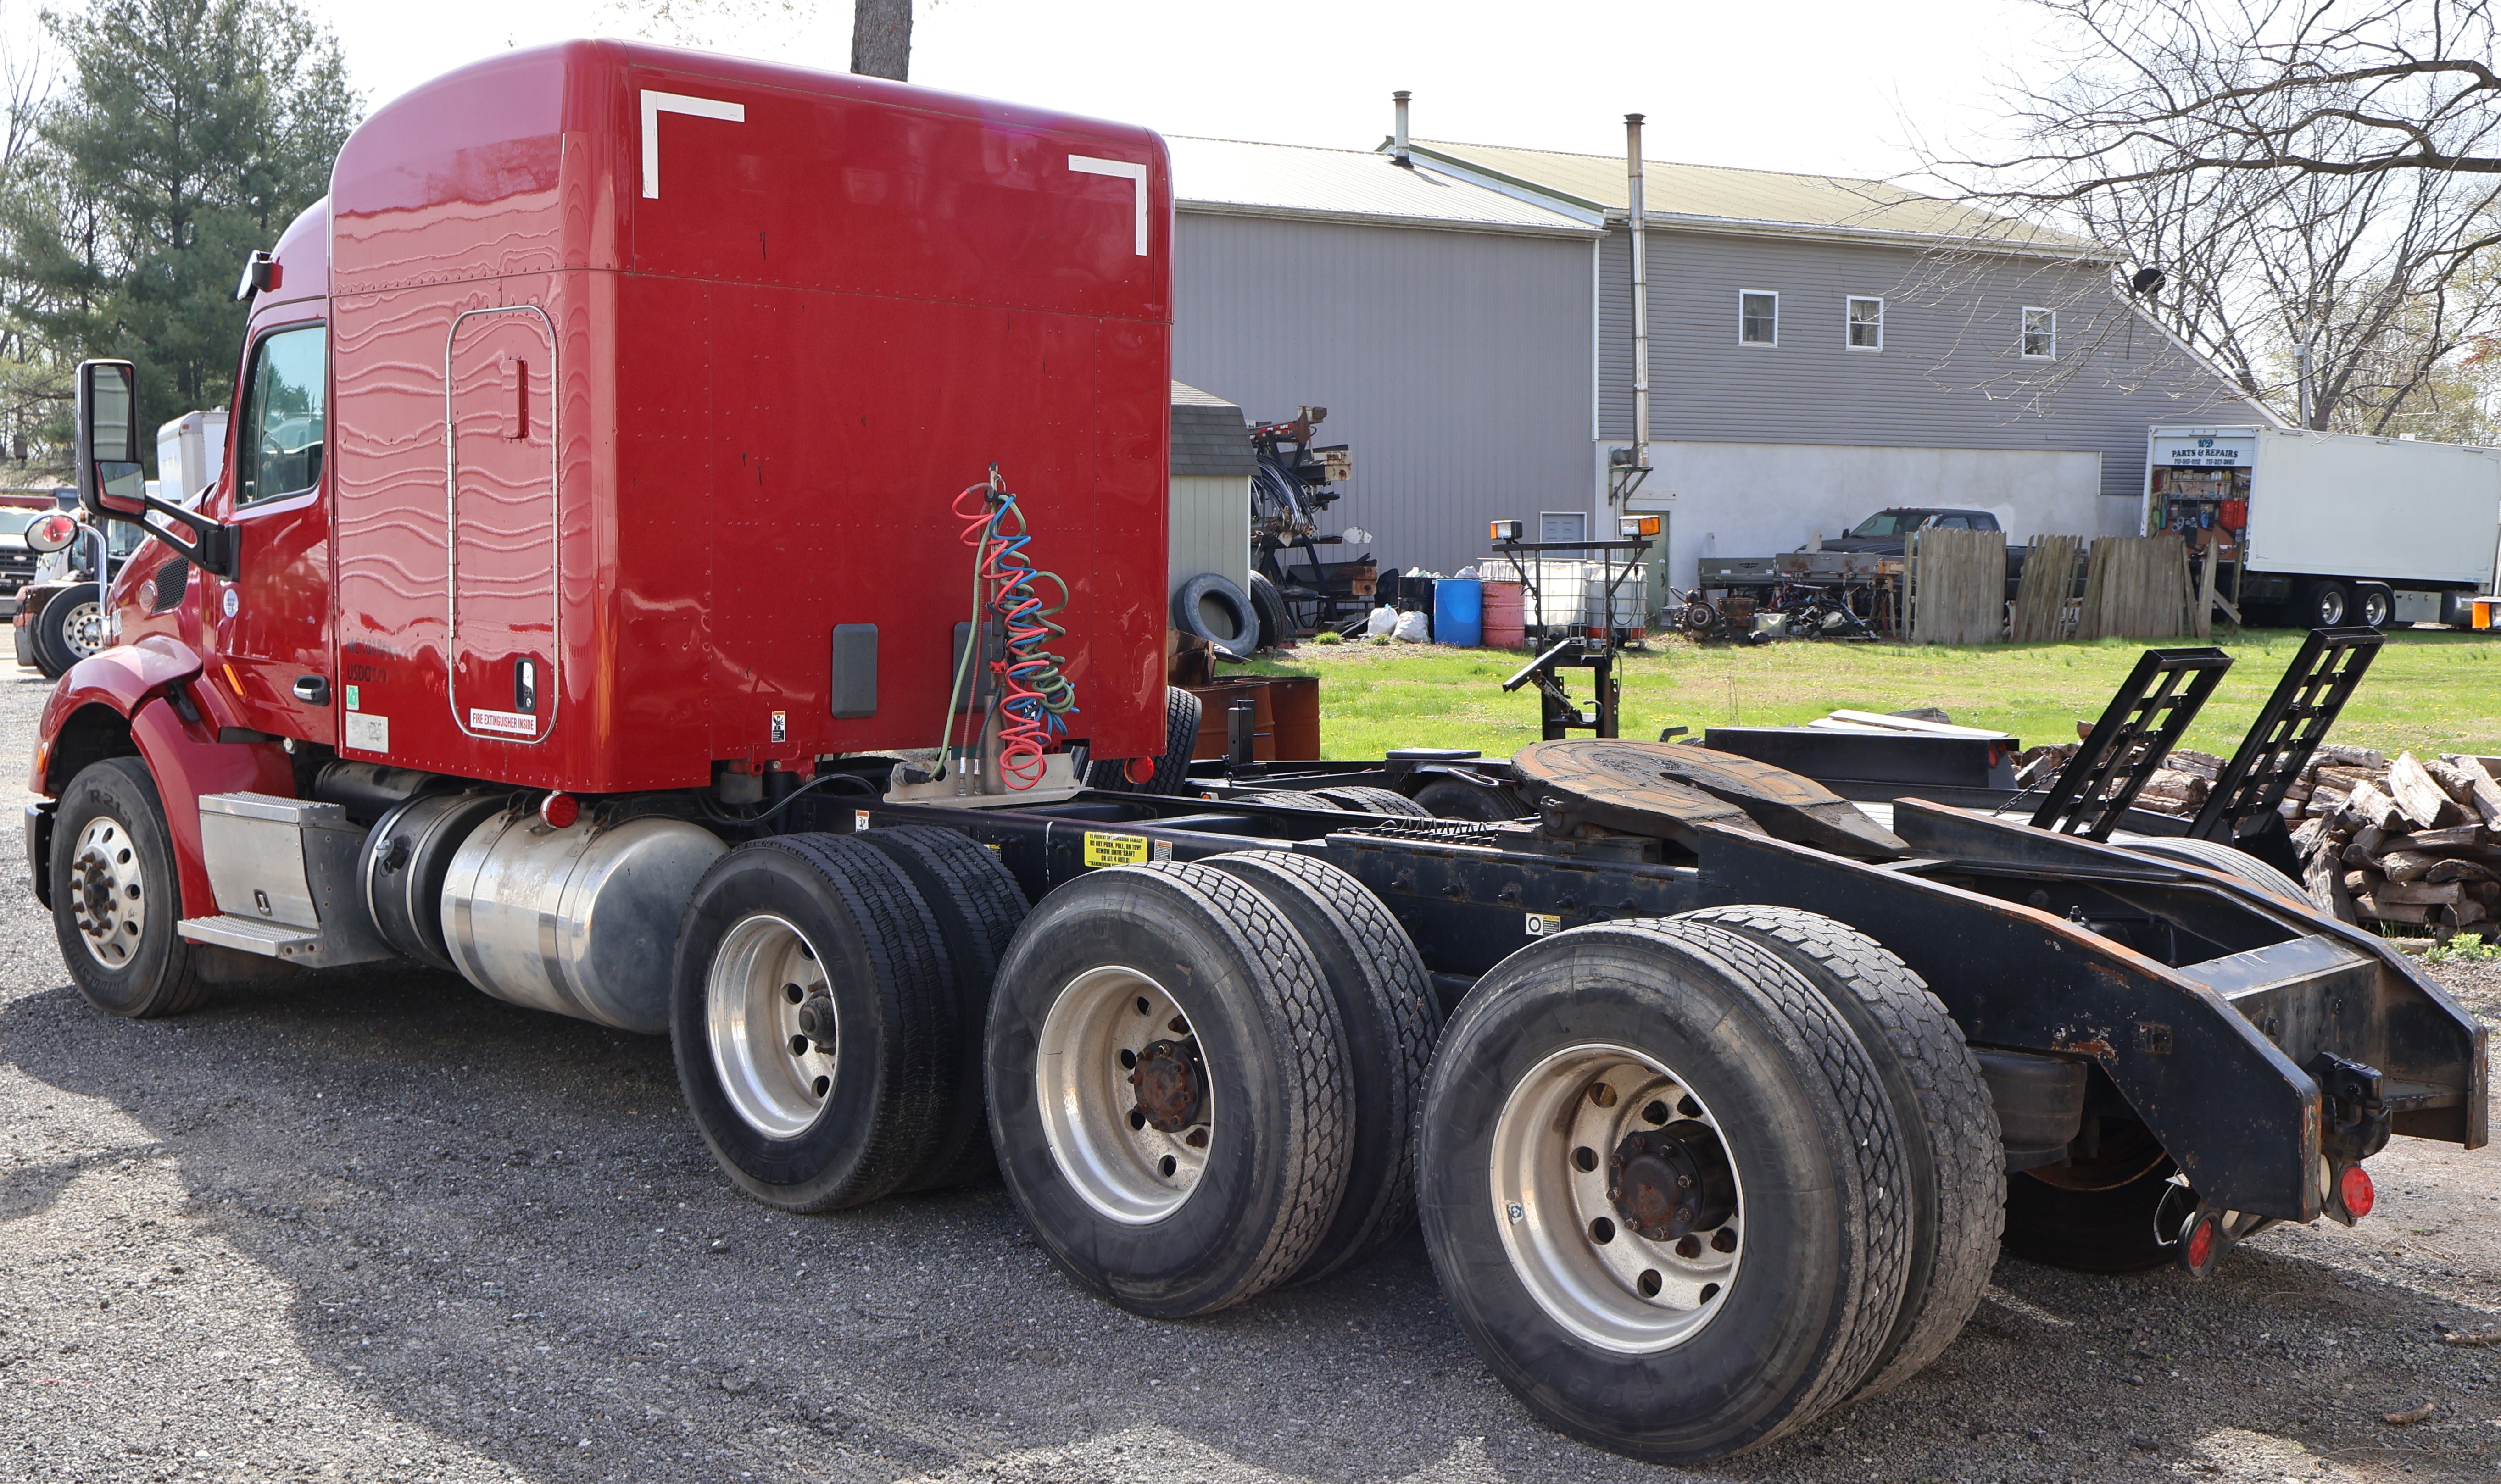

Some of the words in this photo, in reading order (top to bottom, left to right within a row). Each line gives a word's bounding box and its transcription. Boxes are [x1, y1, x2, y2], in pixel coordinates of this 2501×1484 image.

[2206, 449, 2238, 458] REPAIRS
[473, 712, 483, 724] FIRE
[484, 714, 517, 728] EXTINGUISHER
[518, 718, 534, 730] INSIDE
